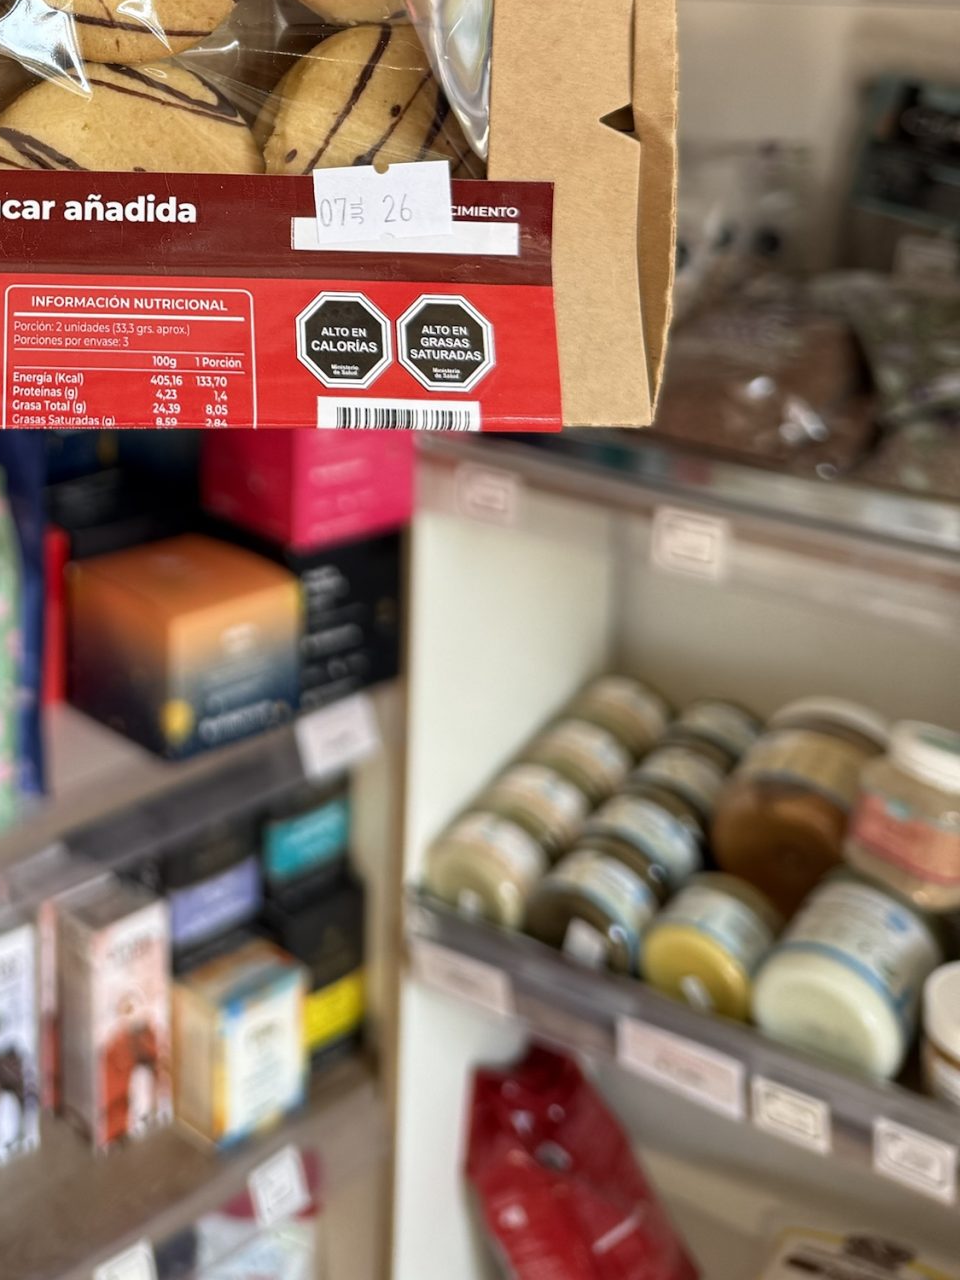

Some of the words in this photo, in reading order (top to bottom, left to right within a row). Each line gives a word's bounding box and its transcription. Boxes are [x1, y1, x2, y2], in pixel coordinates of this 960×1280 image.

[64, 193, 197, 223] añadida
[320, 198, 346, 227] 07
[382, 193, 413, 223] 26
[451, 205, 519, 219] CIMIENTO
[31, 294, 131, 309] INFORMACIÓN
[134, 297, 228, 312] NUTRICIONAL
[13, 320, 55, 332] Porción:
[56, 321, 62, 332] 2
[64, 322, 110, 333] unidades
[321, 327, 349, 337] ALTO
[351, 327, 367, 337] EN
[421, 325, 450, 335] ALTO
[452, 326, 468, 336] EN
[13, 334, 63, 345] Porciones
[65, 337, 81, 347] por
[84, 337, 121, 347] envase:
[122, 336, 129, 347] 3
[311, 340, 378, 353] CALORÍAS
[420, 337, 470, 348] GRASAS
[410, 349, 482, 361] SATURADAS
[152, 356, 177, 369] 100g
[202, 356, 242, 368] Porción
[12, 371, 52, 384] Energía
[55, 372, 84, 386] (Kcal)
[150, 375, 183, 388] 405,16
[196, 376, 228, 388] 133,70
[12, 385, 62, 397] Proteínas
[64, 386, 78, 400] (g)
[155, 389, 177, 401] 4,23
[213, 390, 228, 402] 1,4
[12, 400, 42, 410] Grasa
[44, 400, 70, 411] Total
[72, 400, 87, 414] (g)
[152, 402, 181, 415] 24,39
[12, 413, 46, 424] Grasas
[48, 414, 100, 425] Saturadas
